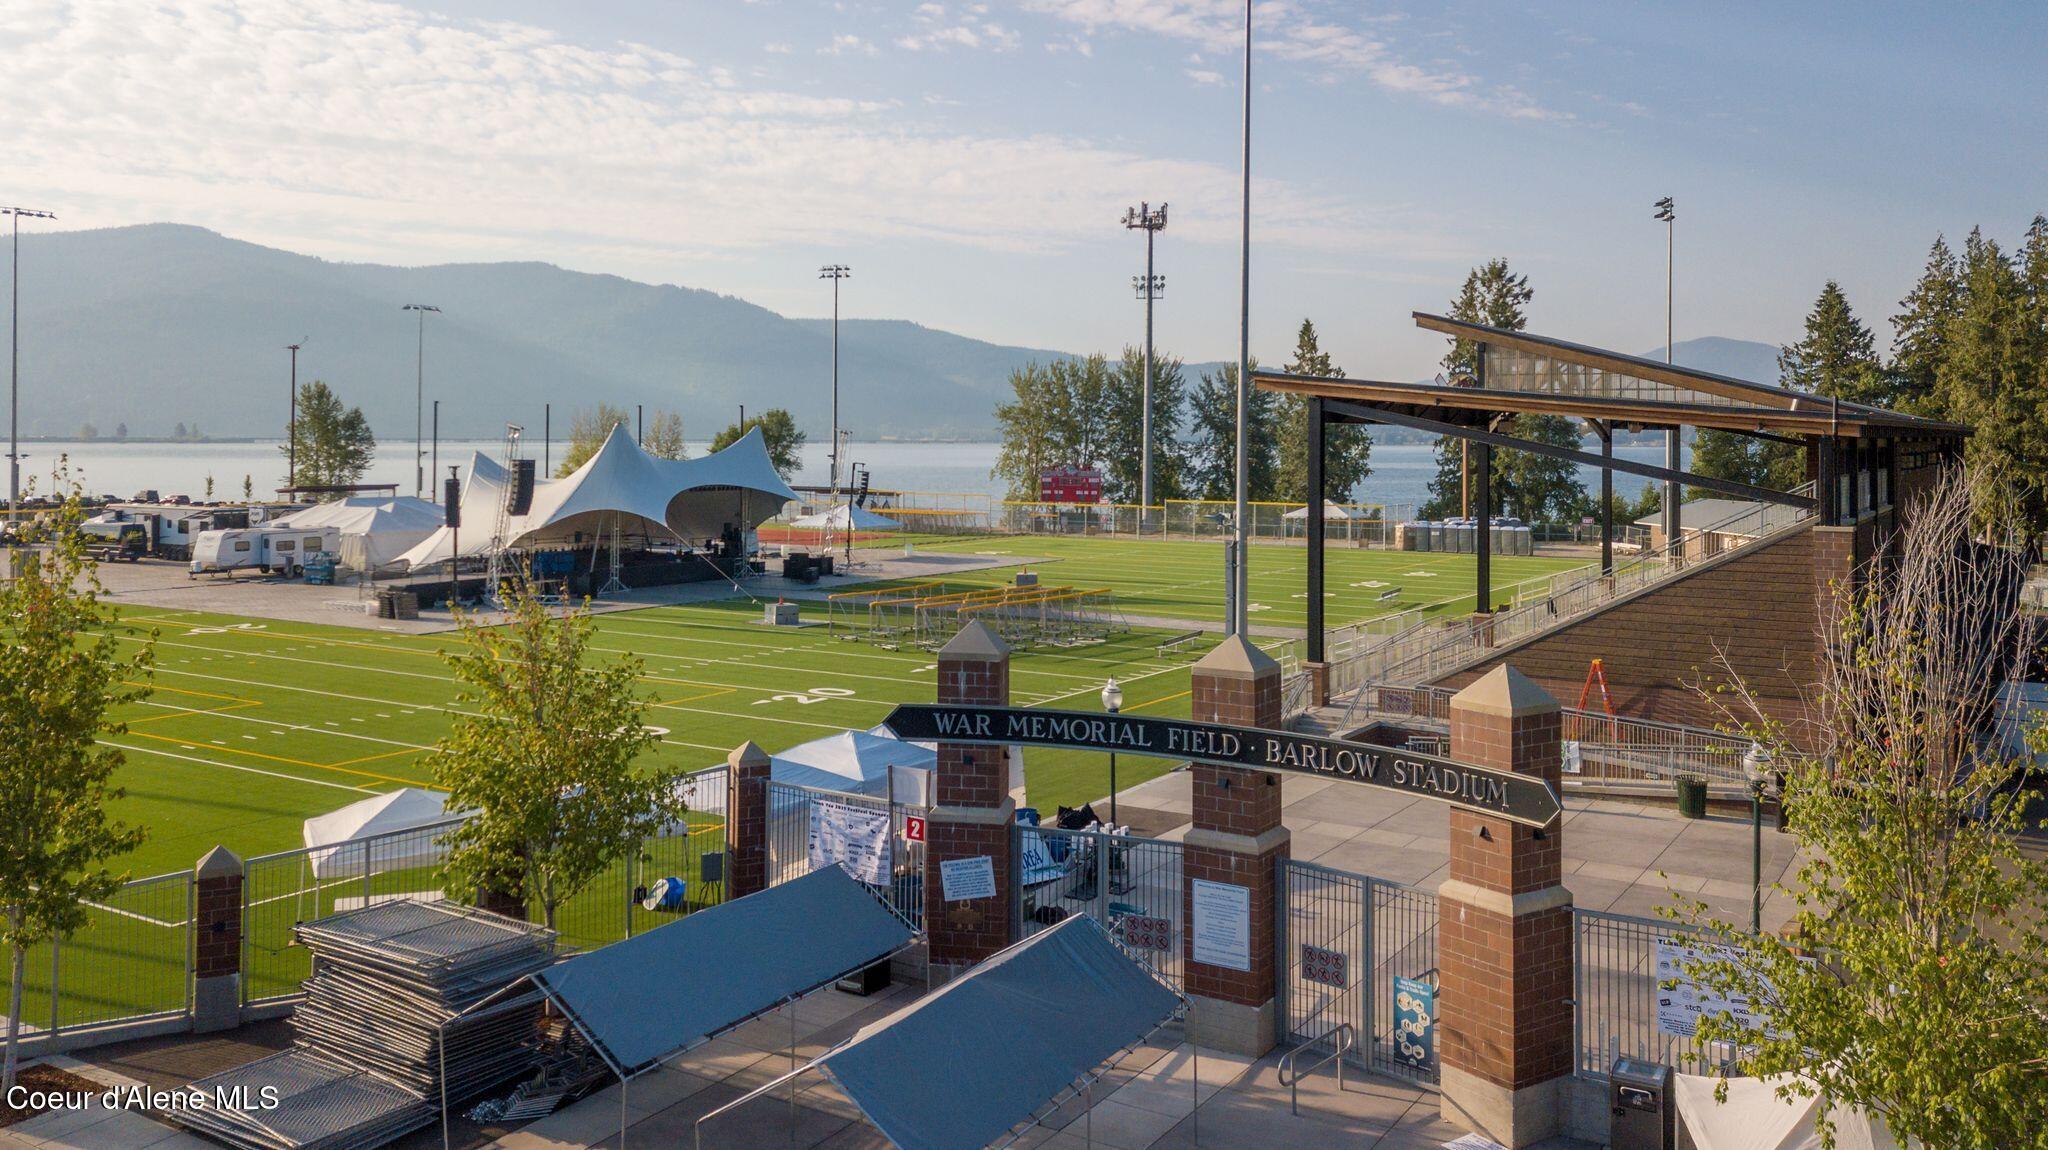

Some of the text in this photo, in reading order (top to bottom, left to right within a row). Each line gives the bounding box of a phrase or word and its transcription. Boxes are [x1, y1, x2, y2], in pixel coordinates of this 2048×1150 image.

[771, 687, 856, 705] 20
[933, 712, 1510, 809] WAR MEMORIAL FIELD BARLOW STADIUM
[911, 820, 920, 838] 2
